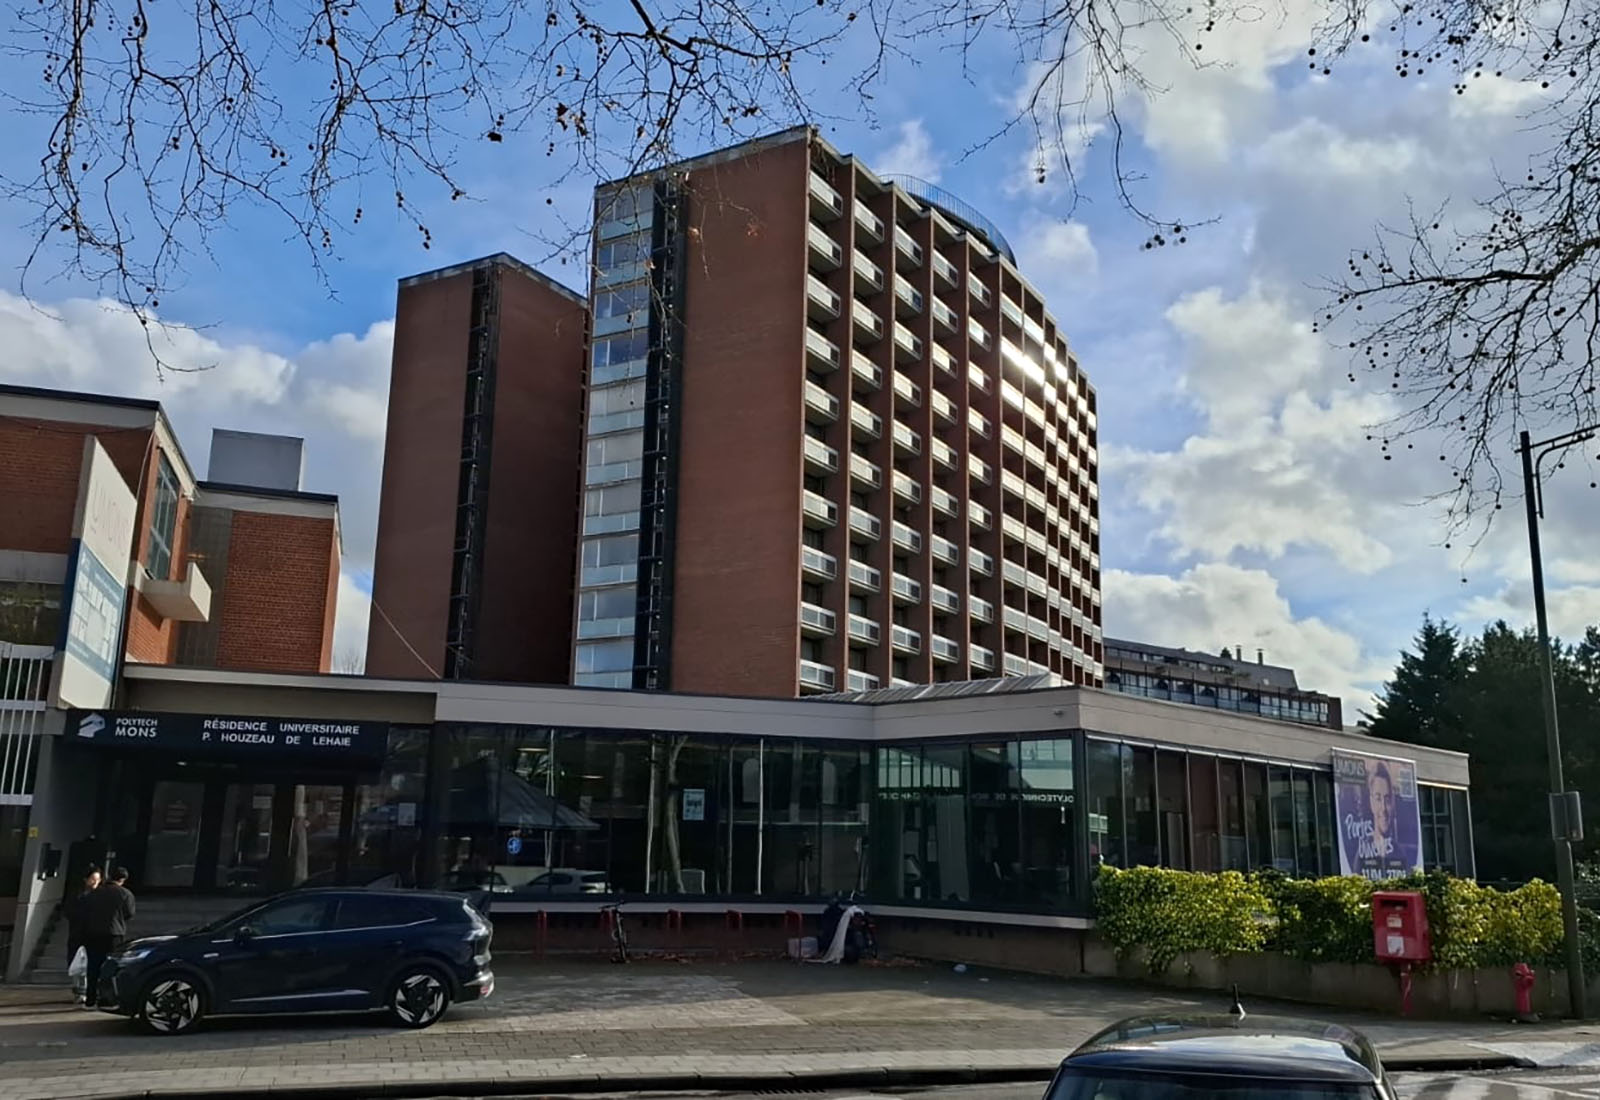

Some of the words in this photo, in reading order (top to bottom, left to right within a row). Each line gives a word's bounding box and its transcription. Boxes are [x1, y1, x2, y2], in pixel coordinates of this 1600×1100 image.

[116, 718, 158, 727] POLYTECH
[203, 718, 268, 731] RÉSIDENCE
[279, 722, 360, 735] UNIVERSITAIRE
[115, 727, 157, 738] MONS
[201, 732, 212, 741] P.
[220, 733, 275, 744] HOUZEAU
[285, 736, 301, 745] DE
[312, 737, 352, 747] LEHAIE
[1345, 814, 1374, 840] Portes
